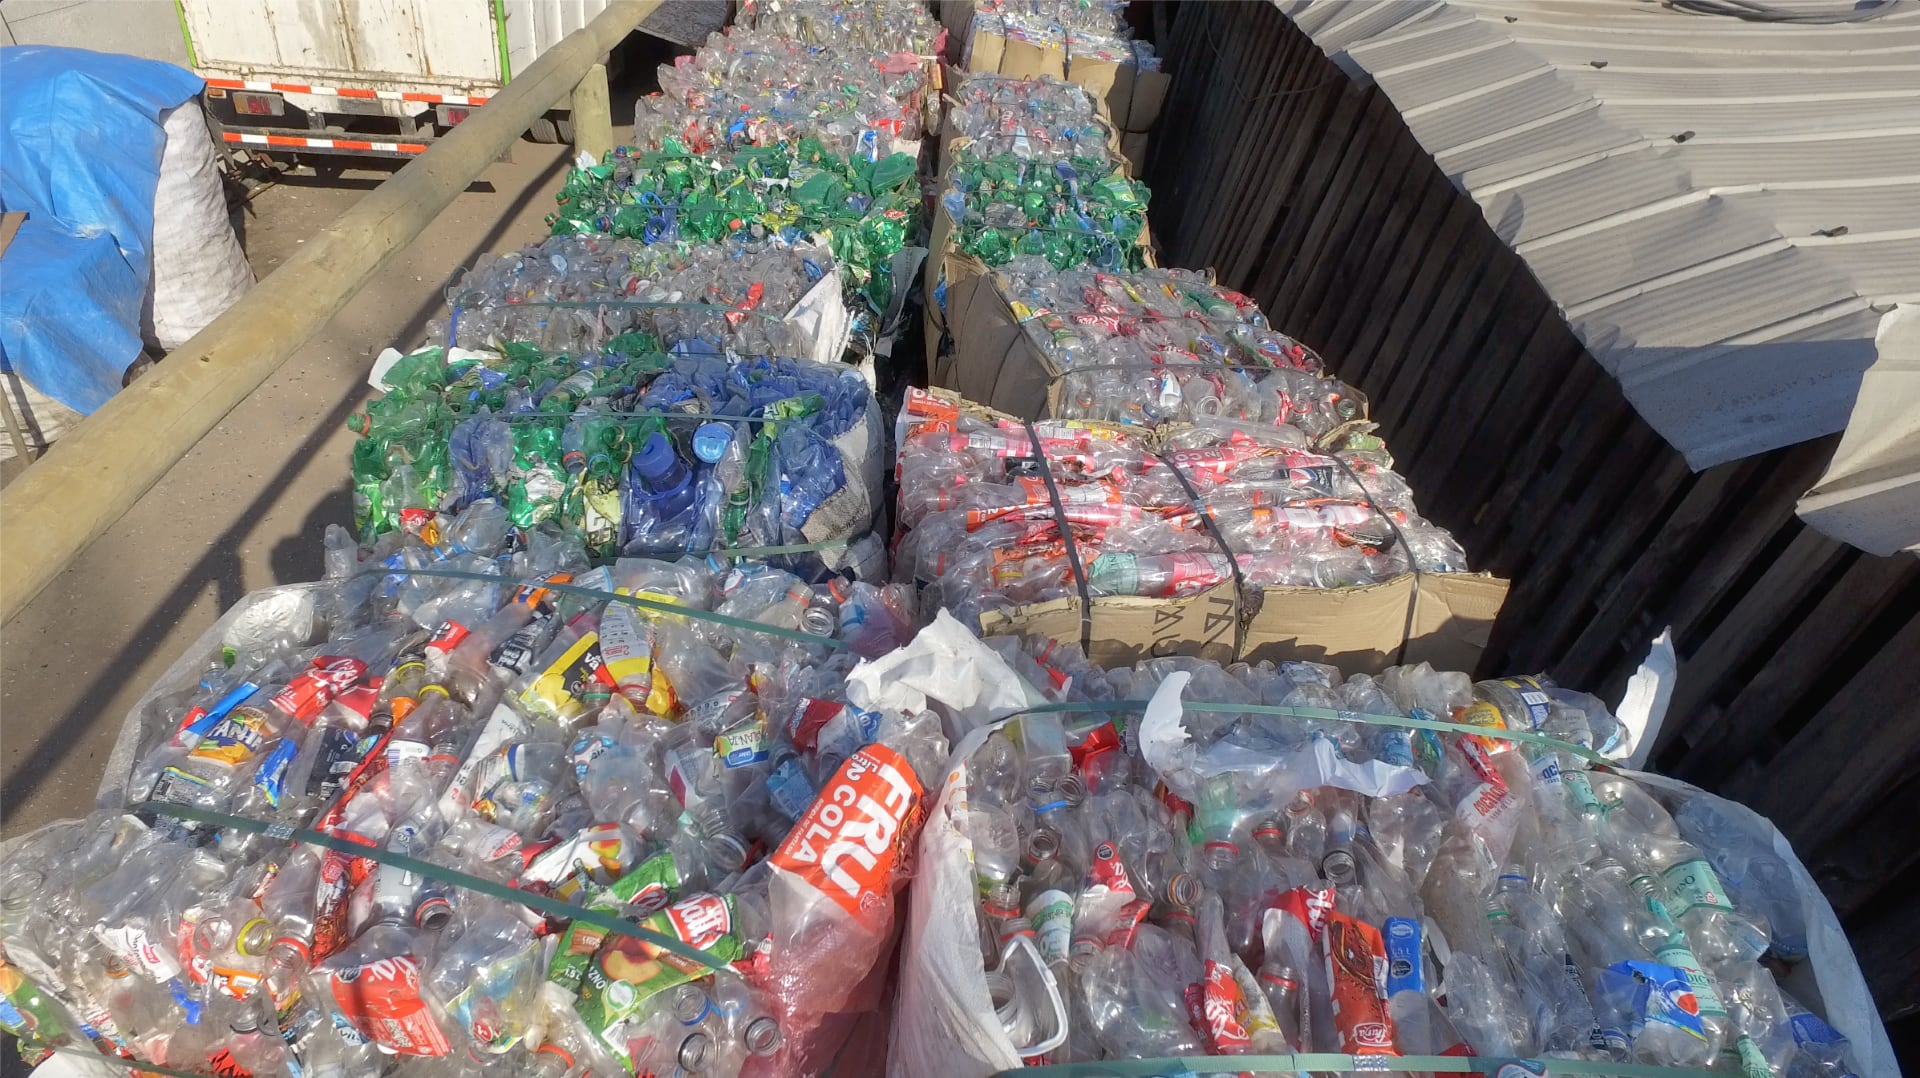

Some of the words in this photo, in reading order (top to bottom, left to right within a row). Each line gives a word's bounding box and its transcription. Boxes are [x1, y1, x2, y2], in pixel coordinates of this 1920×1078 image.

[846, 762, 867, 781] 2
[852, 753, 879, 773] Litro
[791, 784, 857, 863] COLA
[820, 763, 913, 899] FRU
